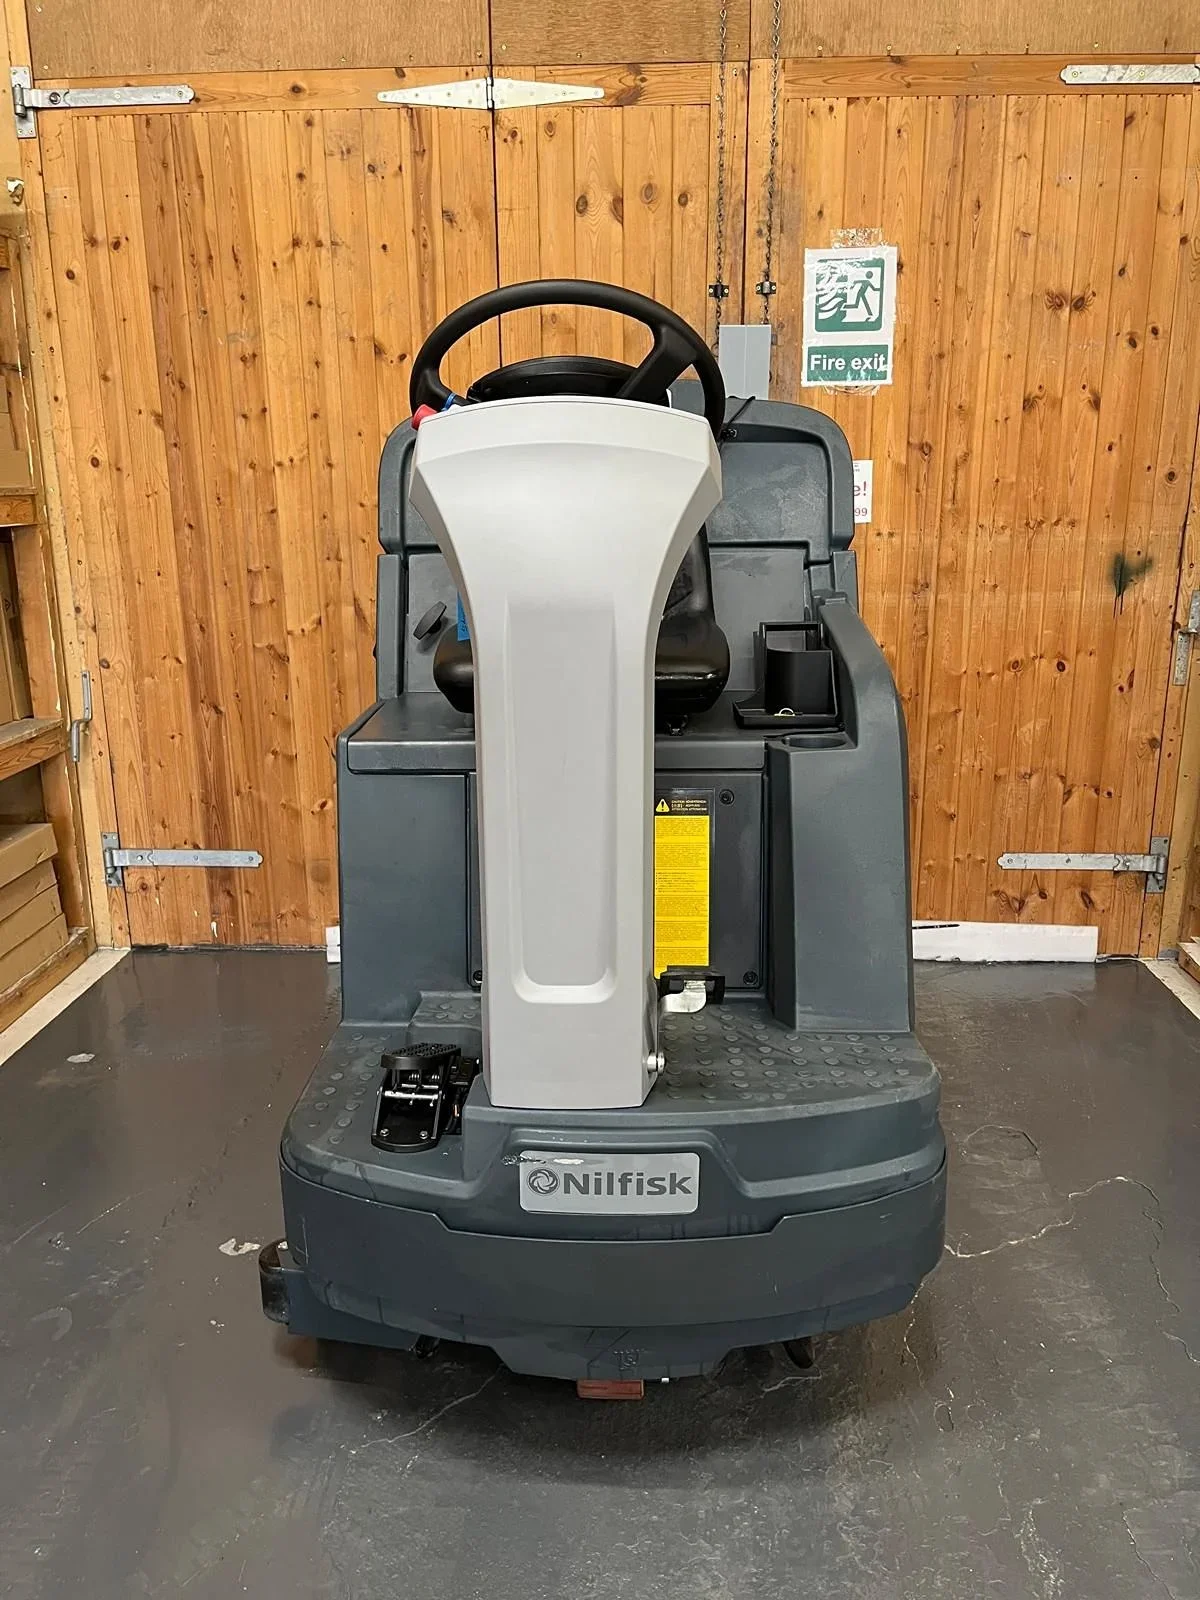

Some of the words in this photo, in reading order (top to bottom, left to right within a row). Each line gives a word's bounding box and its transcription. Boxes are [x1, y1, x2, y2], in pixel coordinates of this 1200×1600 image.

[810, 354, 846, 371] Fire
[851, 353, 886, 371] exit
[563, 1172, 692, 1196] Nilfisk
